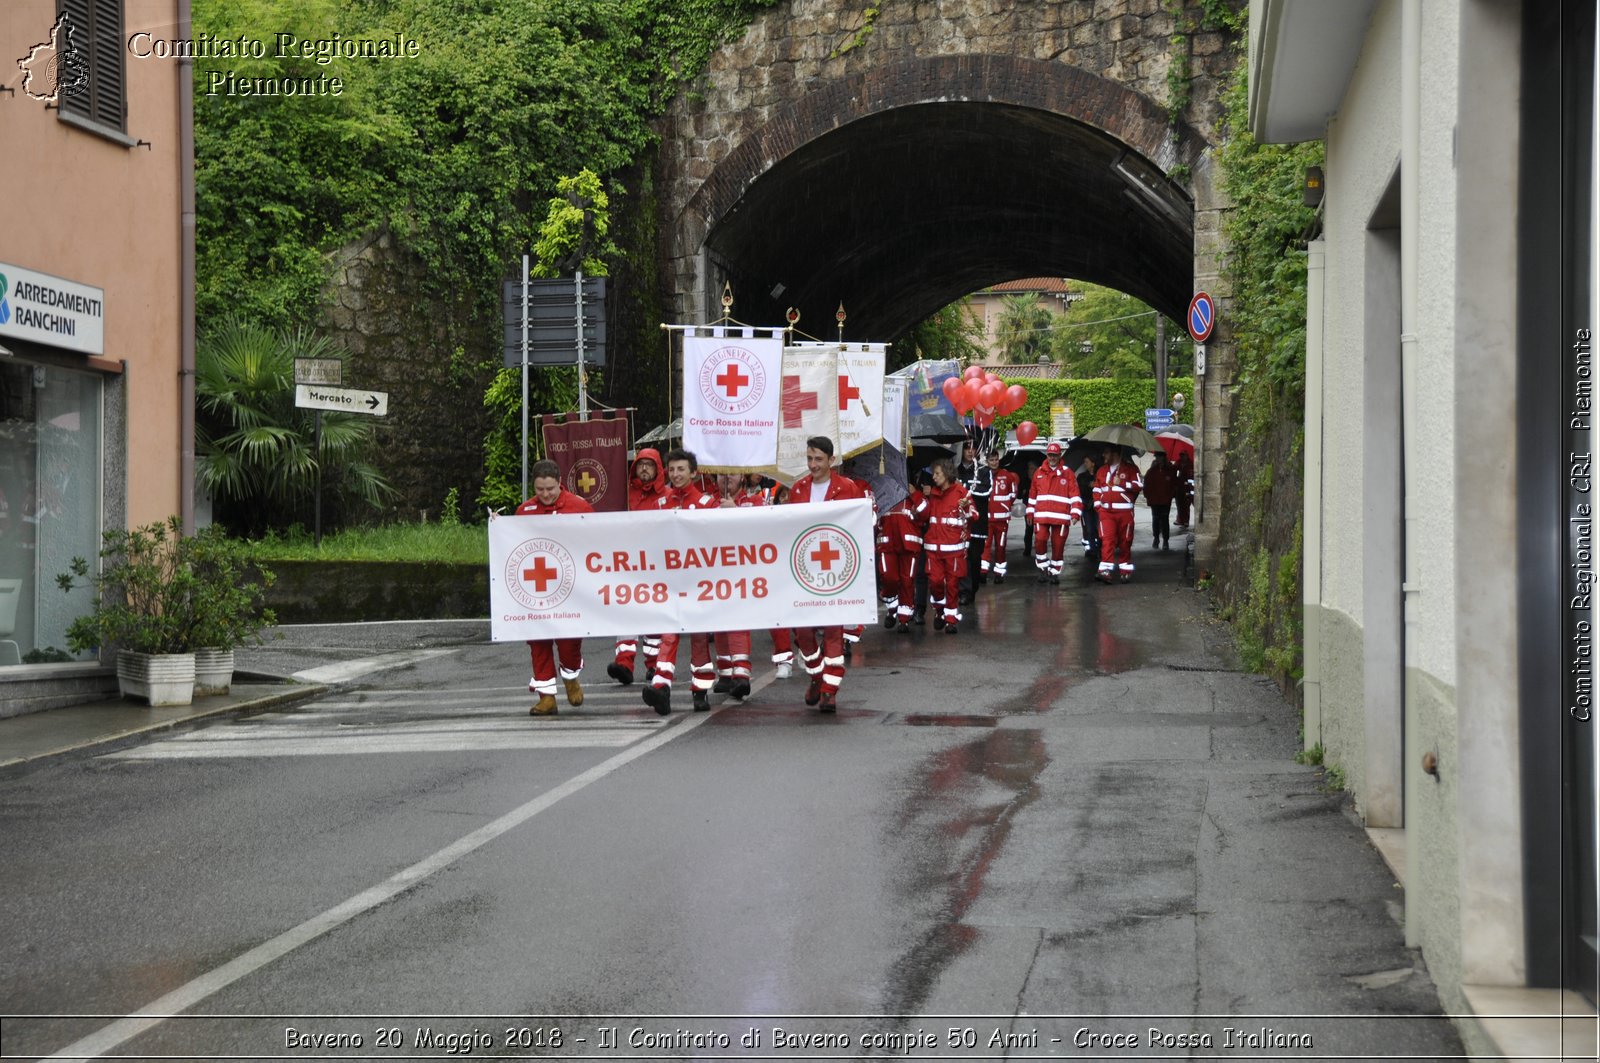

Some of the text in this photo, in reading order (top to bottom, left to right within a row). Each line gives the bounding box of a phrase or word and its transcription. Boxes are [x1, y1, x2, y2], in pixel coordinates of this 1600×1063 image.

[14, 280, 102, 318] ARREDAMENTI
[15, 306, 76, 337] RANCHINI
[717, 348, 751, 362] GINEVRA
[309, 391, 352, 404] Mercato
[689, 417, 774, 427] Croce Rossa Italiana
[701, 428, 728, 436] Comitato
[730, 428, 736, 436] di
[549, 437, 622, 452] CROCE ROSSA ITALIANA
[515, 547, 526, 559] DI
[524, 540, 560, 556] GINEVRA
[585, 543, 778, 573] C.R.I. BAVENO
[816, 571, 837, 588] 50
[597, 582, 669, 606] 1968
[697, 577, 769, 602] 2018
[793, 598, 865, 608] Comitato di Baveno
[503, 611, 581, 622] Croce Rossa Italiana
